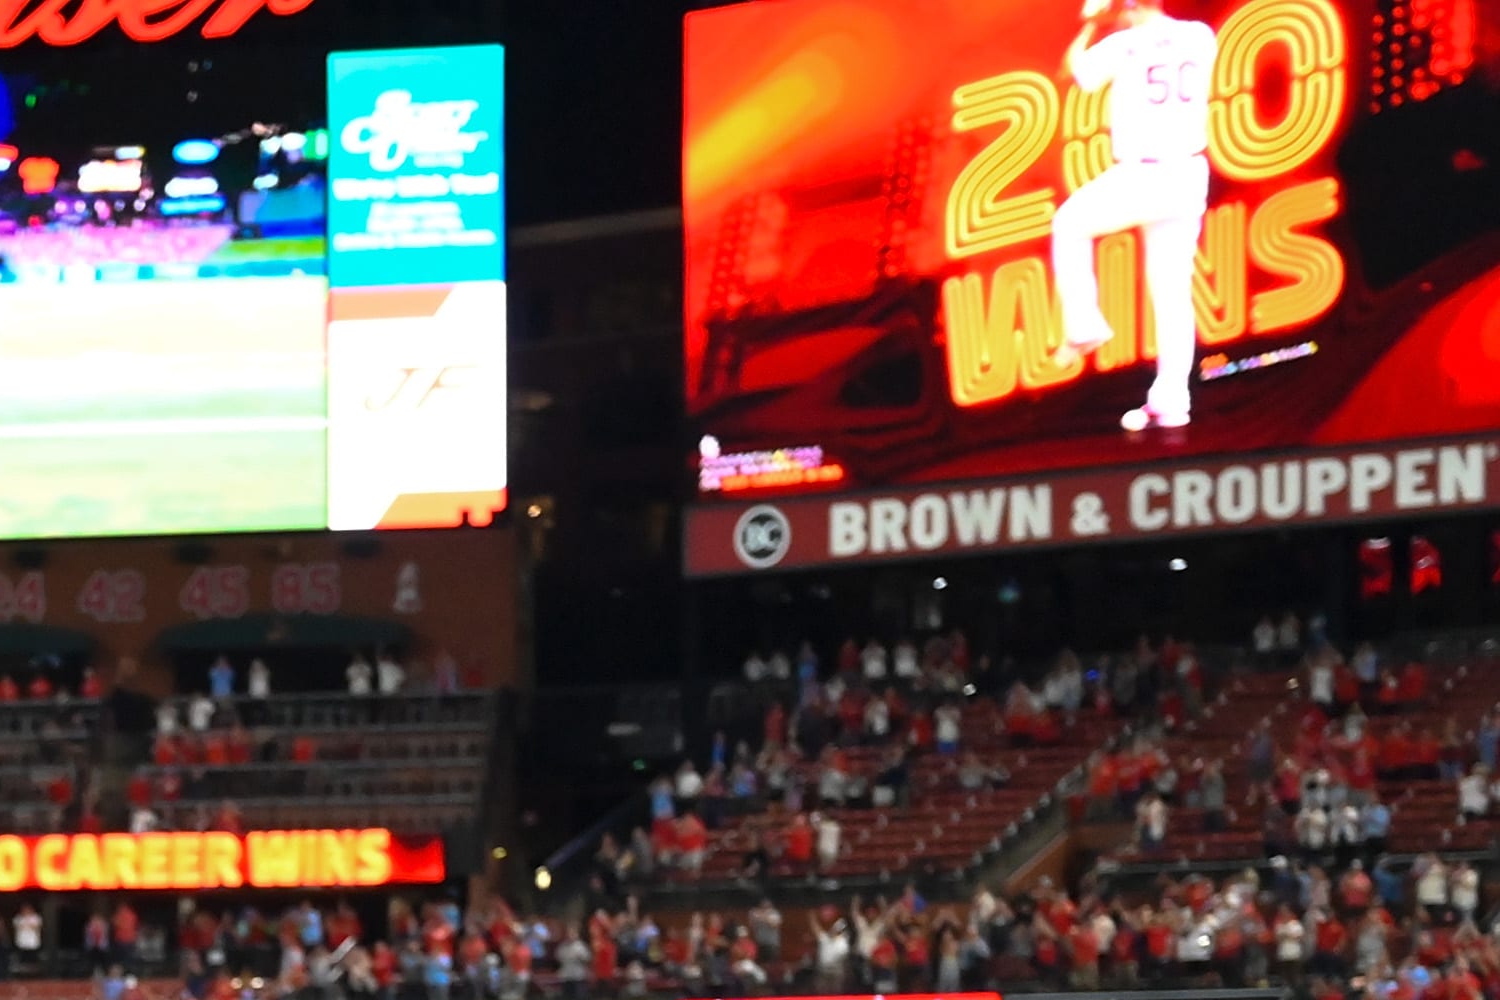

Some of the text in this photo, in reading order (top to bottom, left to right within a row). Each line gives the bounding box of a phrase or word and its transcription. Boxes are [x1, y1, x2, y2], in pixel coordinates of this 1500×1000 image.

[830, 443, 1486, 558] BROWN & CROUPPEN
[34, 831, 242, 889] CAREER
[246, 828, 393, 888] WINS
